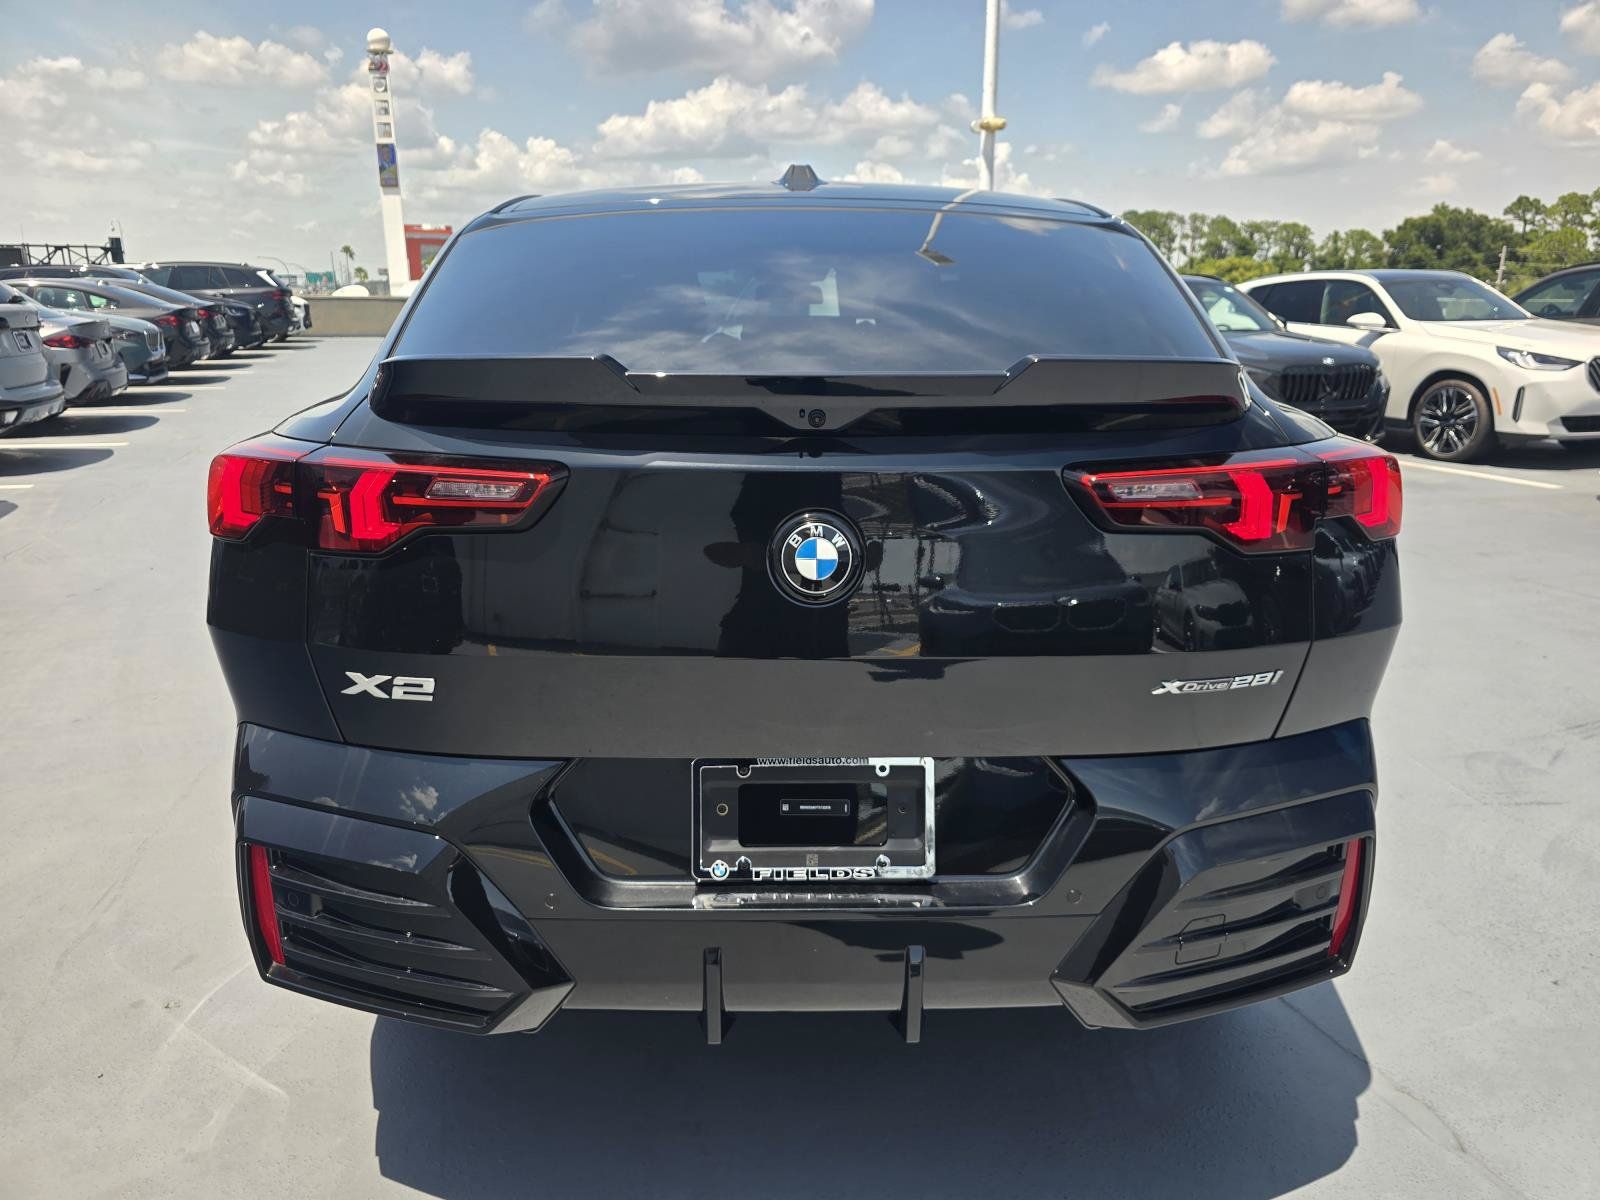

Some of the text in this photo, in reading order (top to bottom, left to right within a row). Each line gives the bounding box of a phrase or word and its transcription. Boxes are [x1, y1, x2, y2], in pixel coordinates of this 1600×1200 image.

[788, 525, 846, 549] BMW
[340, 671, 436, 702] X2
[757, 757, 869, 766] www.fieldsauto.com
[752, 867, 876, 881] FIELDS
